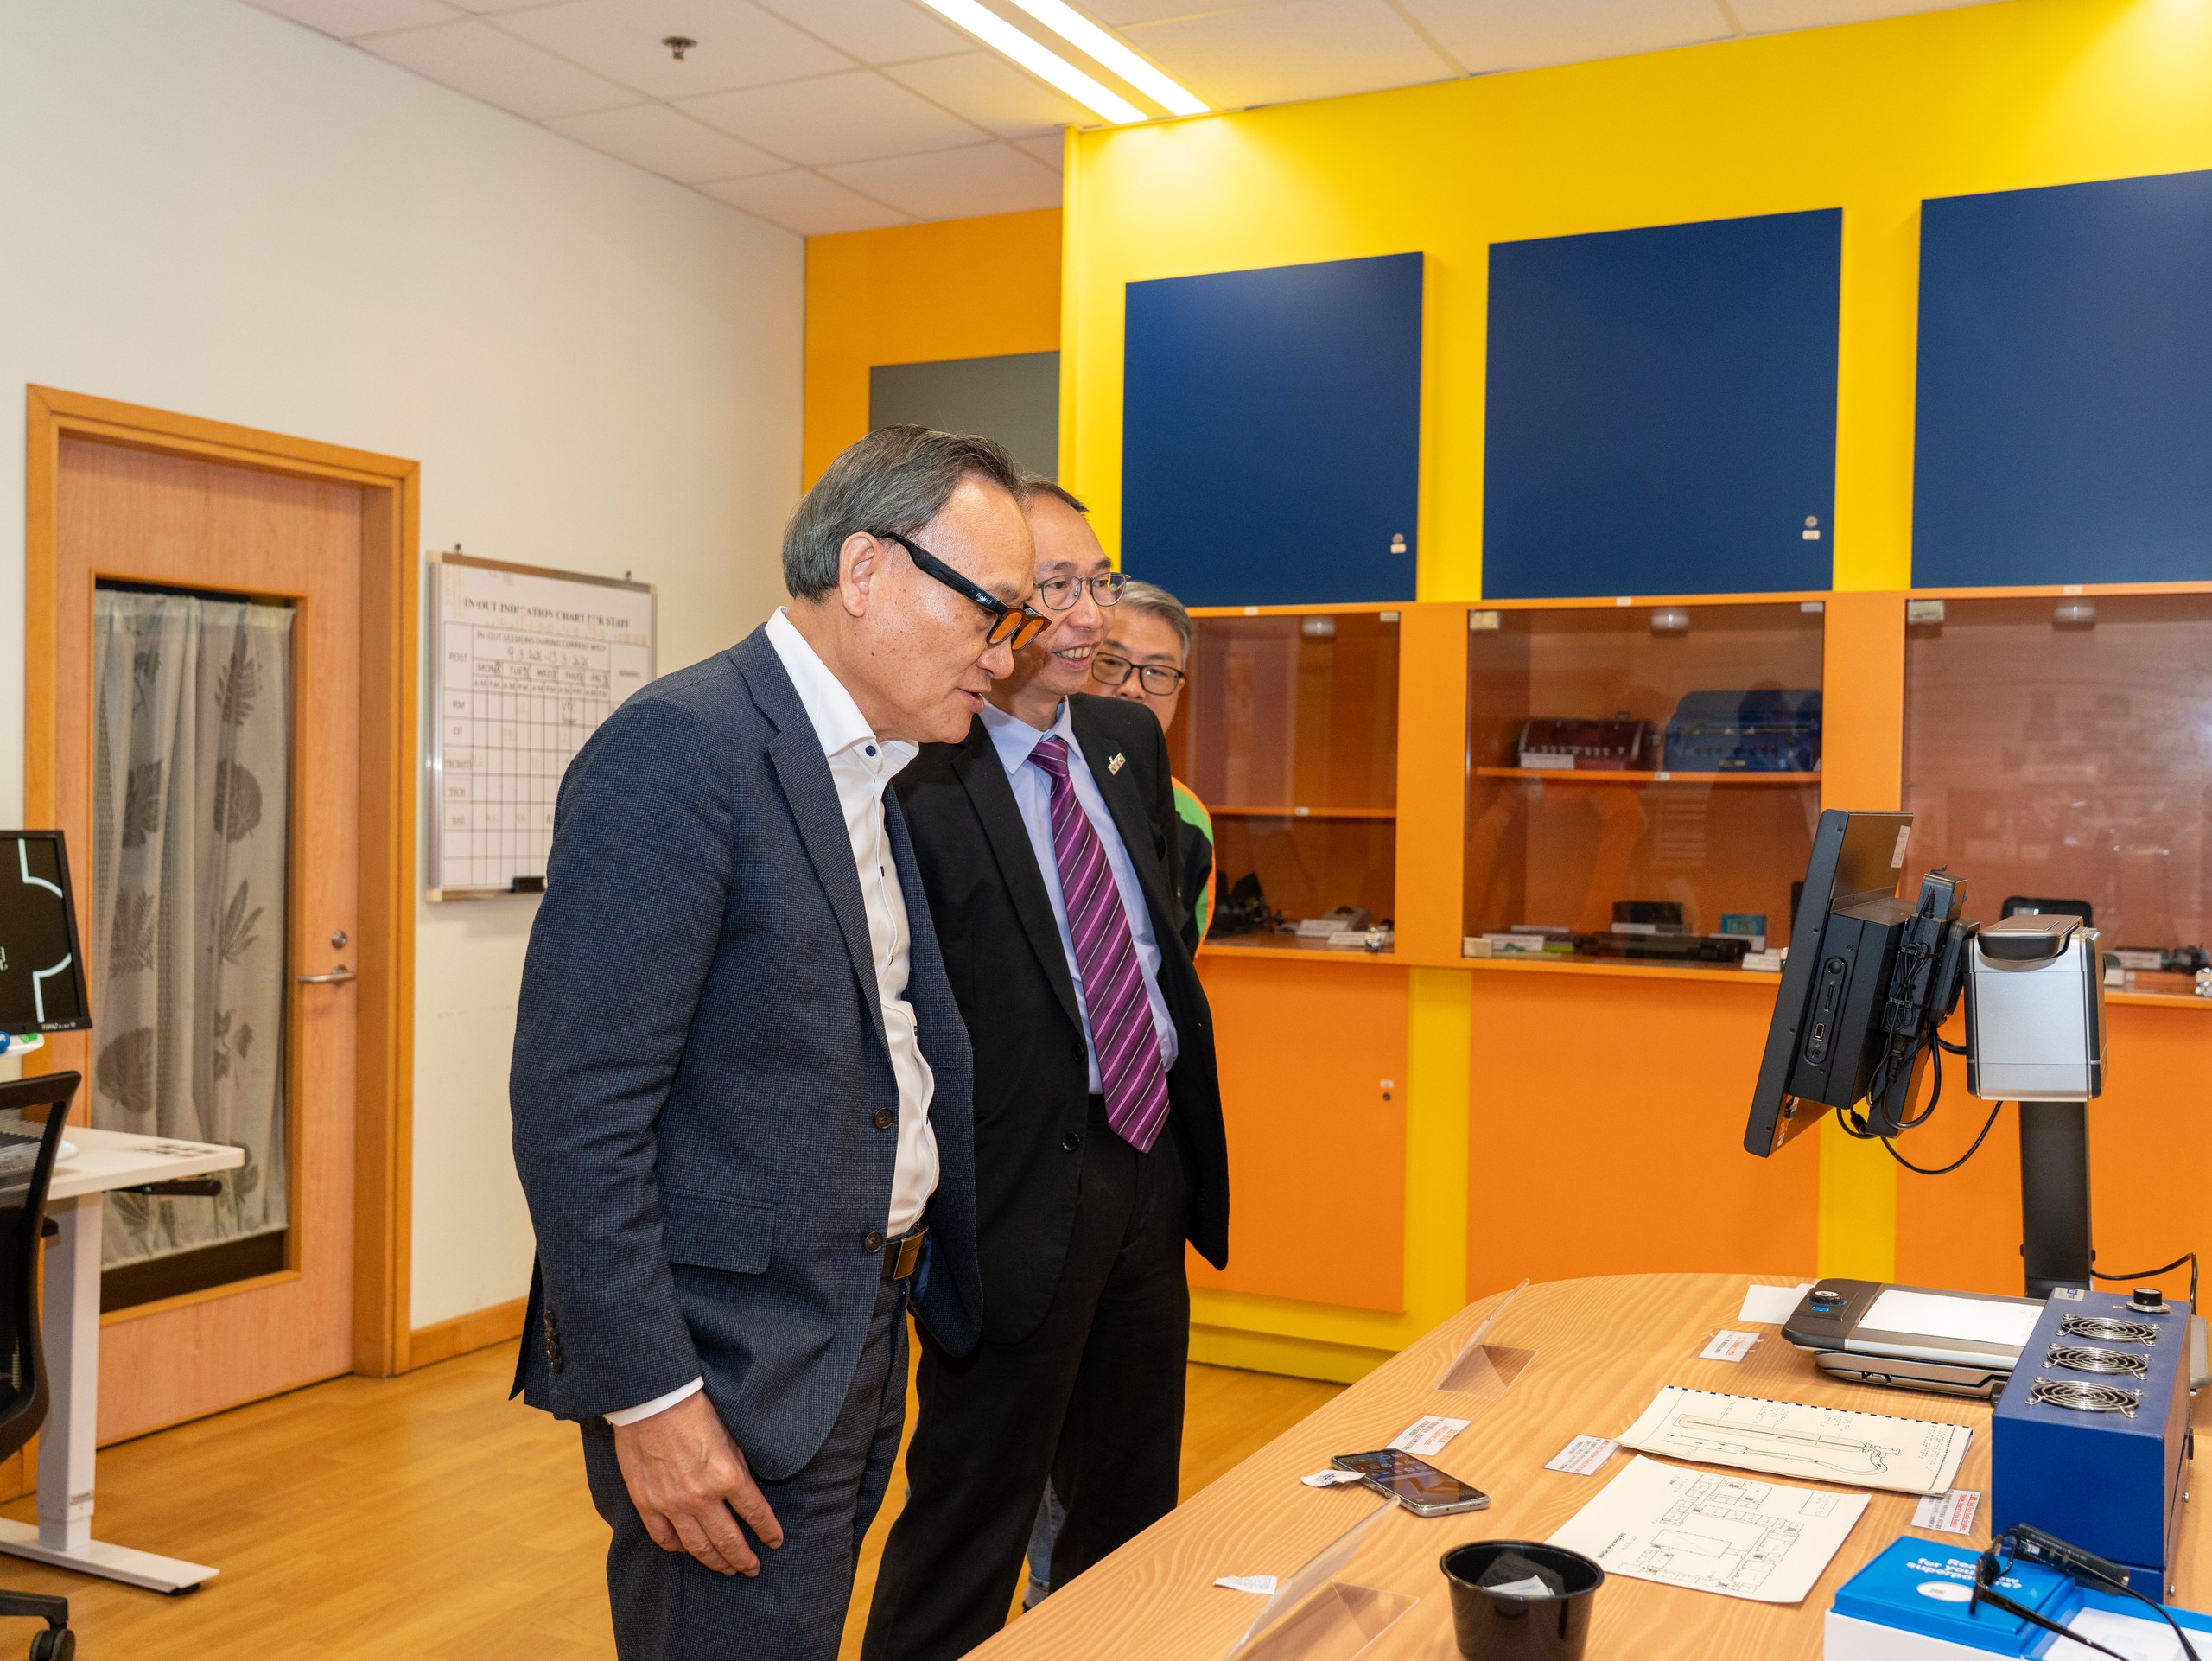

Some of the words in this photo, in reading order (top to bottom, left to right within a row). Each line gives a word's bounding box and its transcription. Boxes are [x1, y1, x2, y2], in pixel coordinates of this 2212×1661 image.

[976, 592, 992, 605] Rokid
[500, 603, 554, 618] INDIATION
[556, 609, 584, 622] CHART
[606, 617, 629, 629] STAFF
[449, 652, 467, 663] POST
[1917, 1557, 1942, 1568] for
[1944, 1564, 1977, 1575] you
